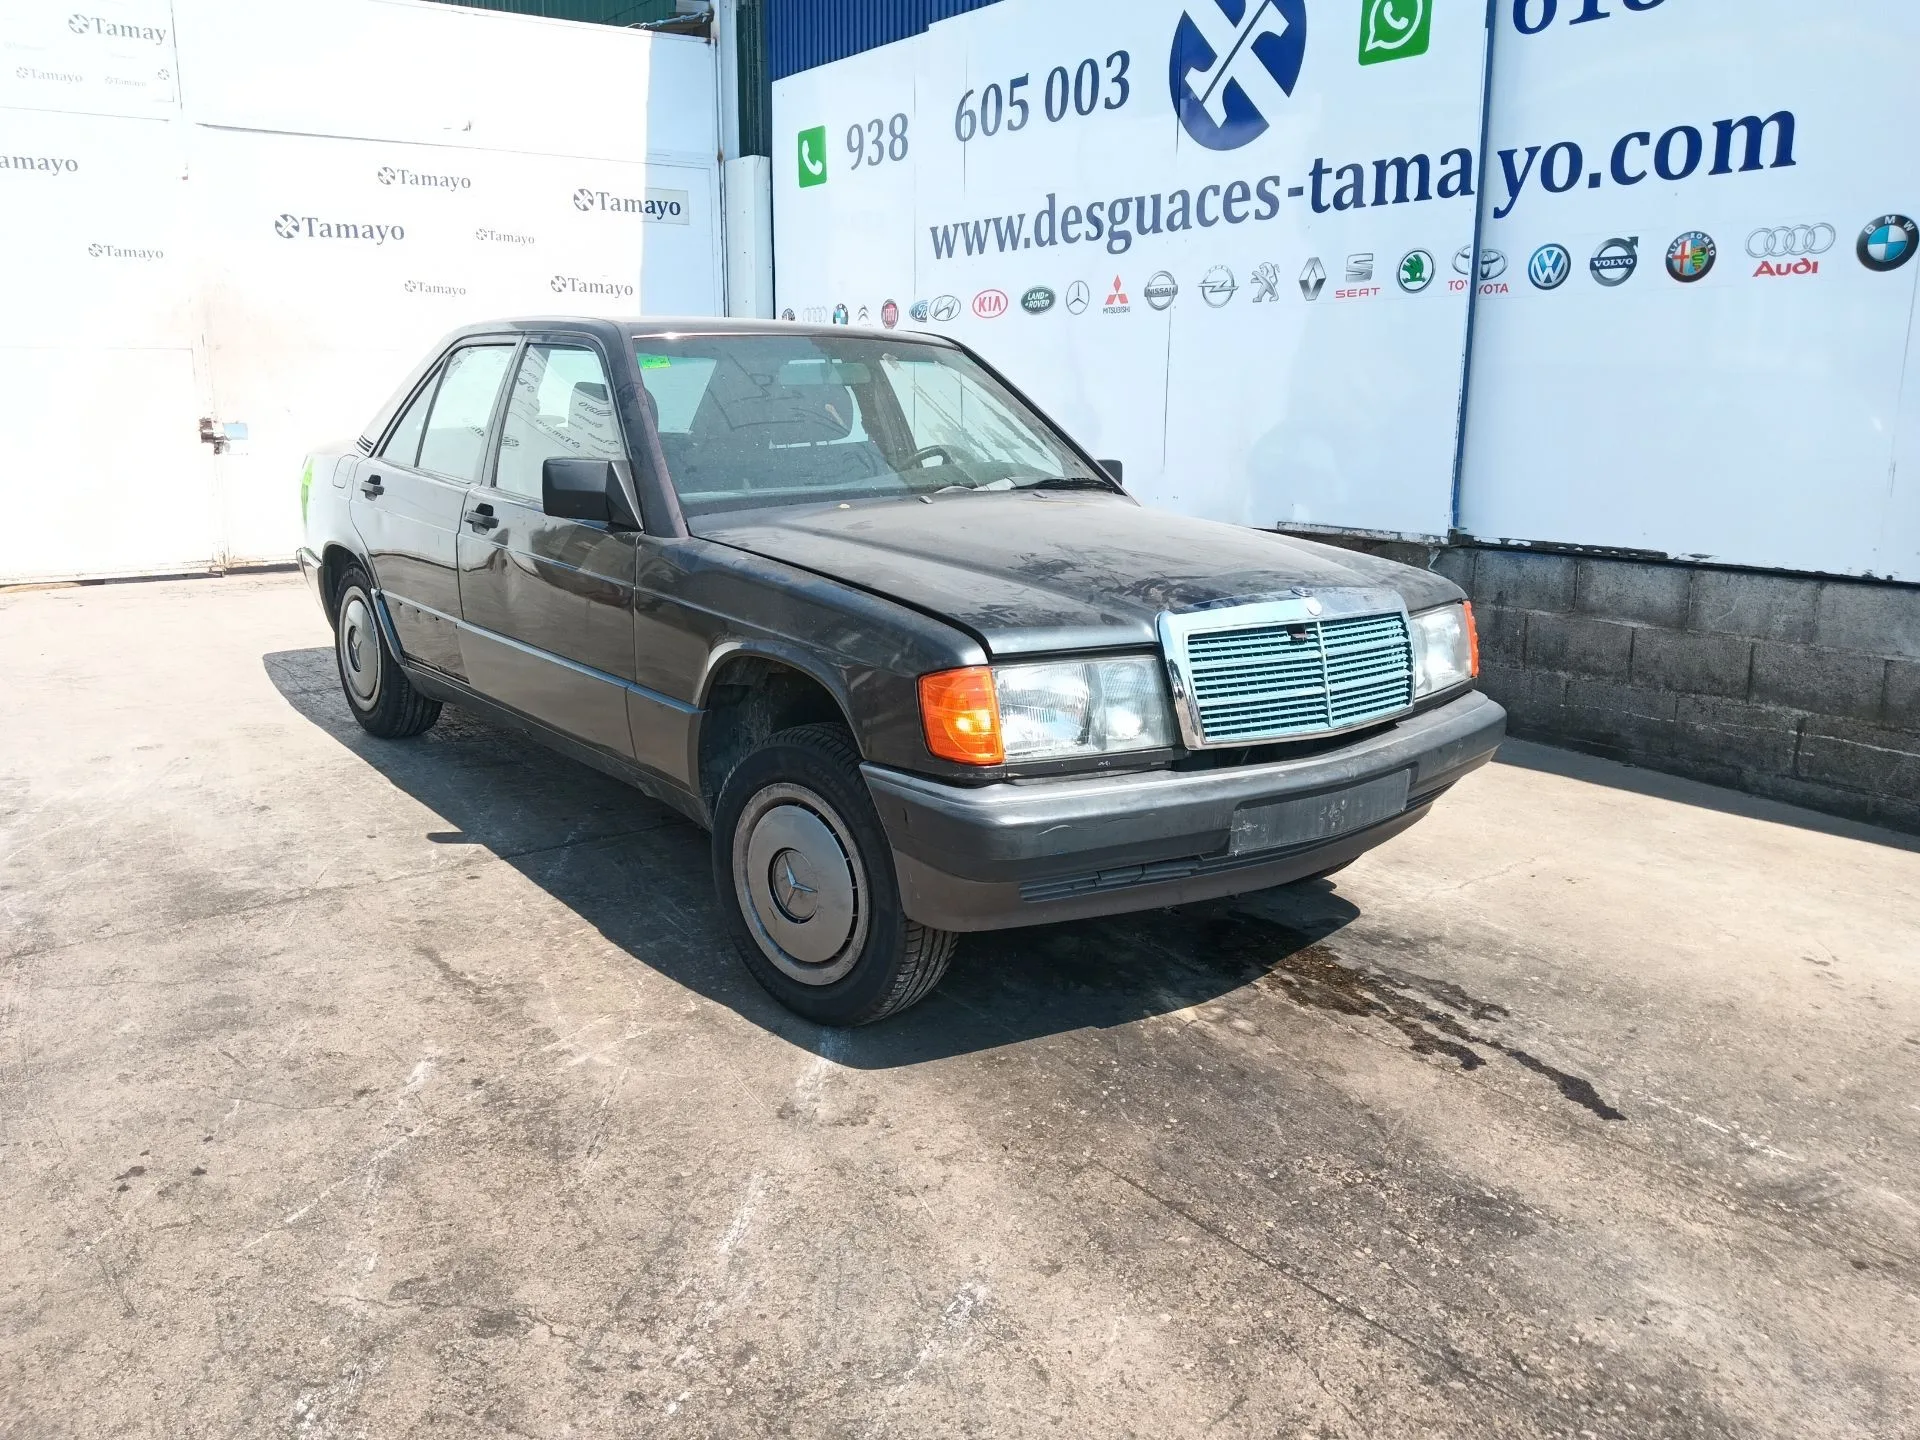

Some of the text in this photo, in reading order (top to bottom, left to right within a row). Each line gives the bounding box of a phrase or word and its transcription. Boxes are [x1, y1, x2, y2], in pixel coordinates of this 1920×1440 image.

[29, 67, 83, 84] Tamayo
[846, 50, 1131, 171] 938 605 003
[0, 155, 79, 176] amayo
[397, 168, 471, 192] Tamayo
[596, 191, 681, 220] Tamayo
[301, 217, 405, 245] Tamayo
[1864, 215, 1915, 235] BMW
[487, 230, 535, 246] Tamayo
[103, 245, 164, 262] Tamayo
[1593, 257, 1634, 268] VOLVO
[1752, 258, 1819, 278] Audi
[417, 282, 467, 296] Tamayo
[568, 276, 634, 298] Tamayo
[1146, 285, 1176, 297] NISSAN
[1335, 286, 1381, 299] SEAT
[978, 295, 1002, 312] KIA
[1027, 291, 1045, 301] LAND
[1028, 298, 1050, 309] ROVER
[1102, 304, 1131, 315] MITSUBISHI
